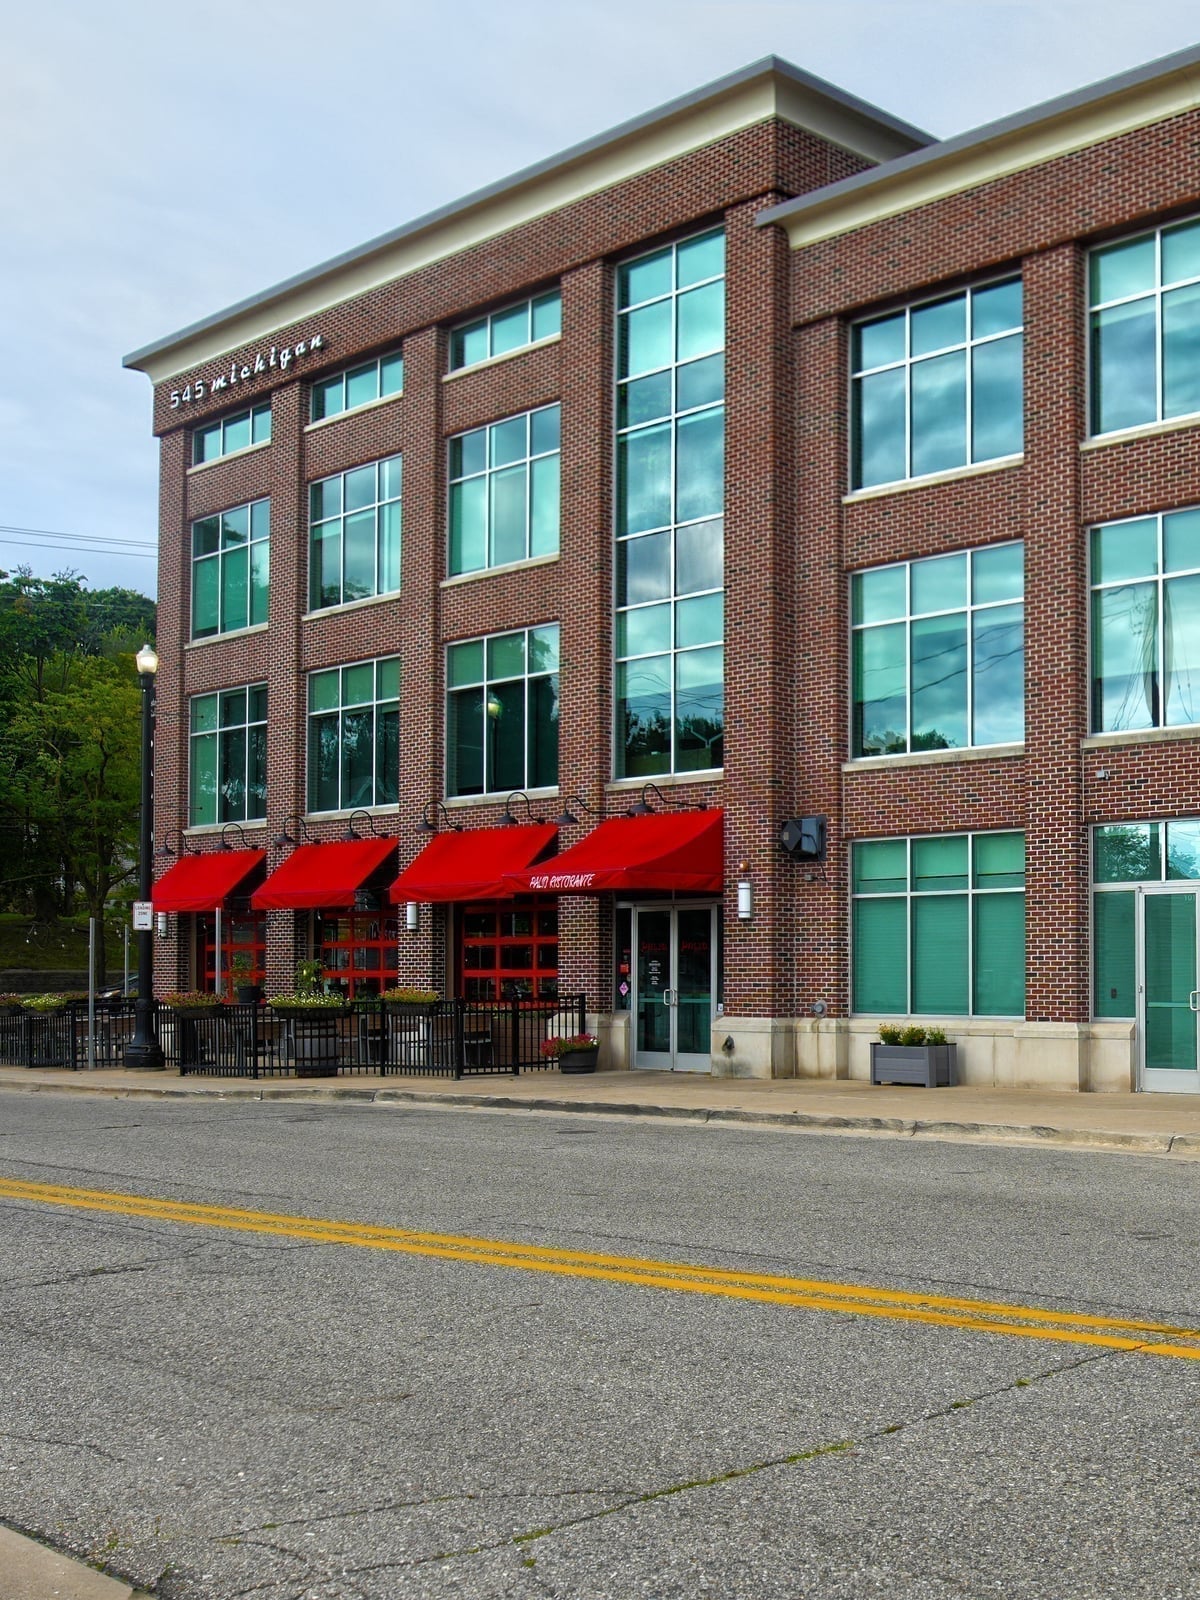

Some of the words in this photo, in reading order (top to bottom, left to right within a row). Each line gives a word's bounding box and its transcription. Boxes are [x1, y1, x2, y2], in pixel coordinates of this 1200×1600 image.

[170, 379, 204, 409] 545
[210, 334, 324, 392] michigan
[530, 875, 548, 889] PALIO
[549, 873, 595, 889] RISTORANTE
